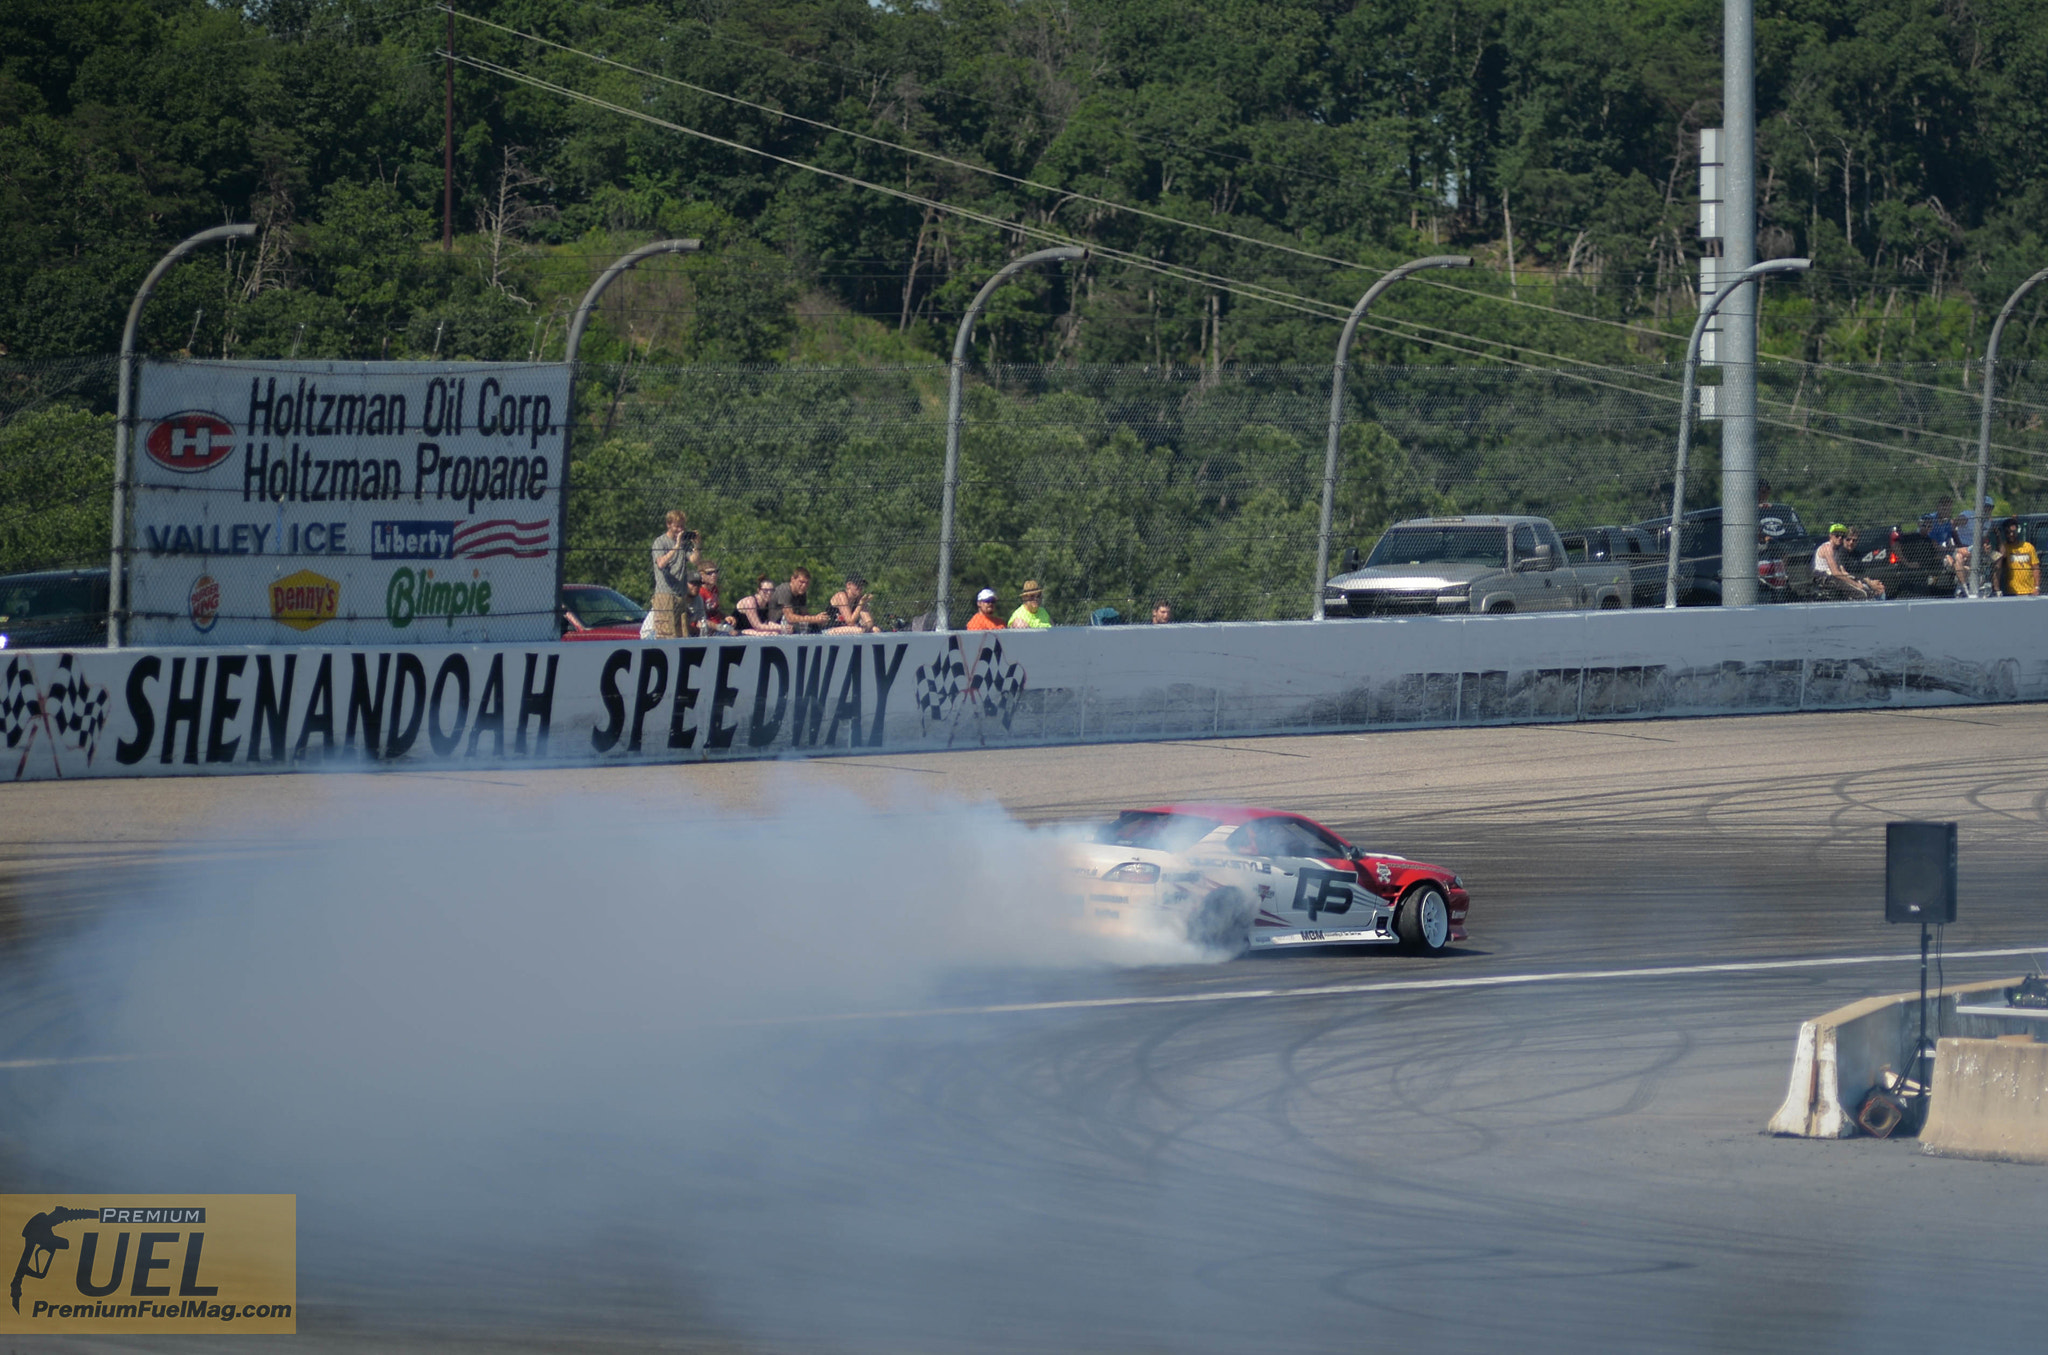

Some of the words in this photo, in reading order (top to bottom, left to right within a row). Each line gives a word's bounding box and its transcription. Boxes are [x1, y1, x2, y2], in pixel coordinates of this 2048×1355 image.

[248, 377, 406, 437] Holtzman
[423, 377, 465, 437] Oil
[478, 377, 557, 449] Corp.
[244, 443, 401, 502] Holtzman
[414, 442, 549, 514] Propane
[147, 523, 271, 553] VALLEY
[289, 522, 348, 553] ICE
[374, 524, 451, 559] Liberty
[191, 583, 219, 605] BURGER
[192, 594, 220, 621] KING
[273, 582, 336, 615] Denny's
[386, 566, 491, 628] Blimpie
[115, 652, 559, 766] SHENANDOAH
[591, 643, 909, 753] SPEEDWAY
